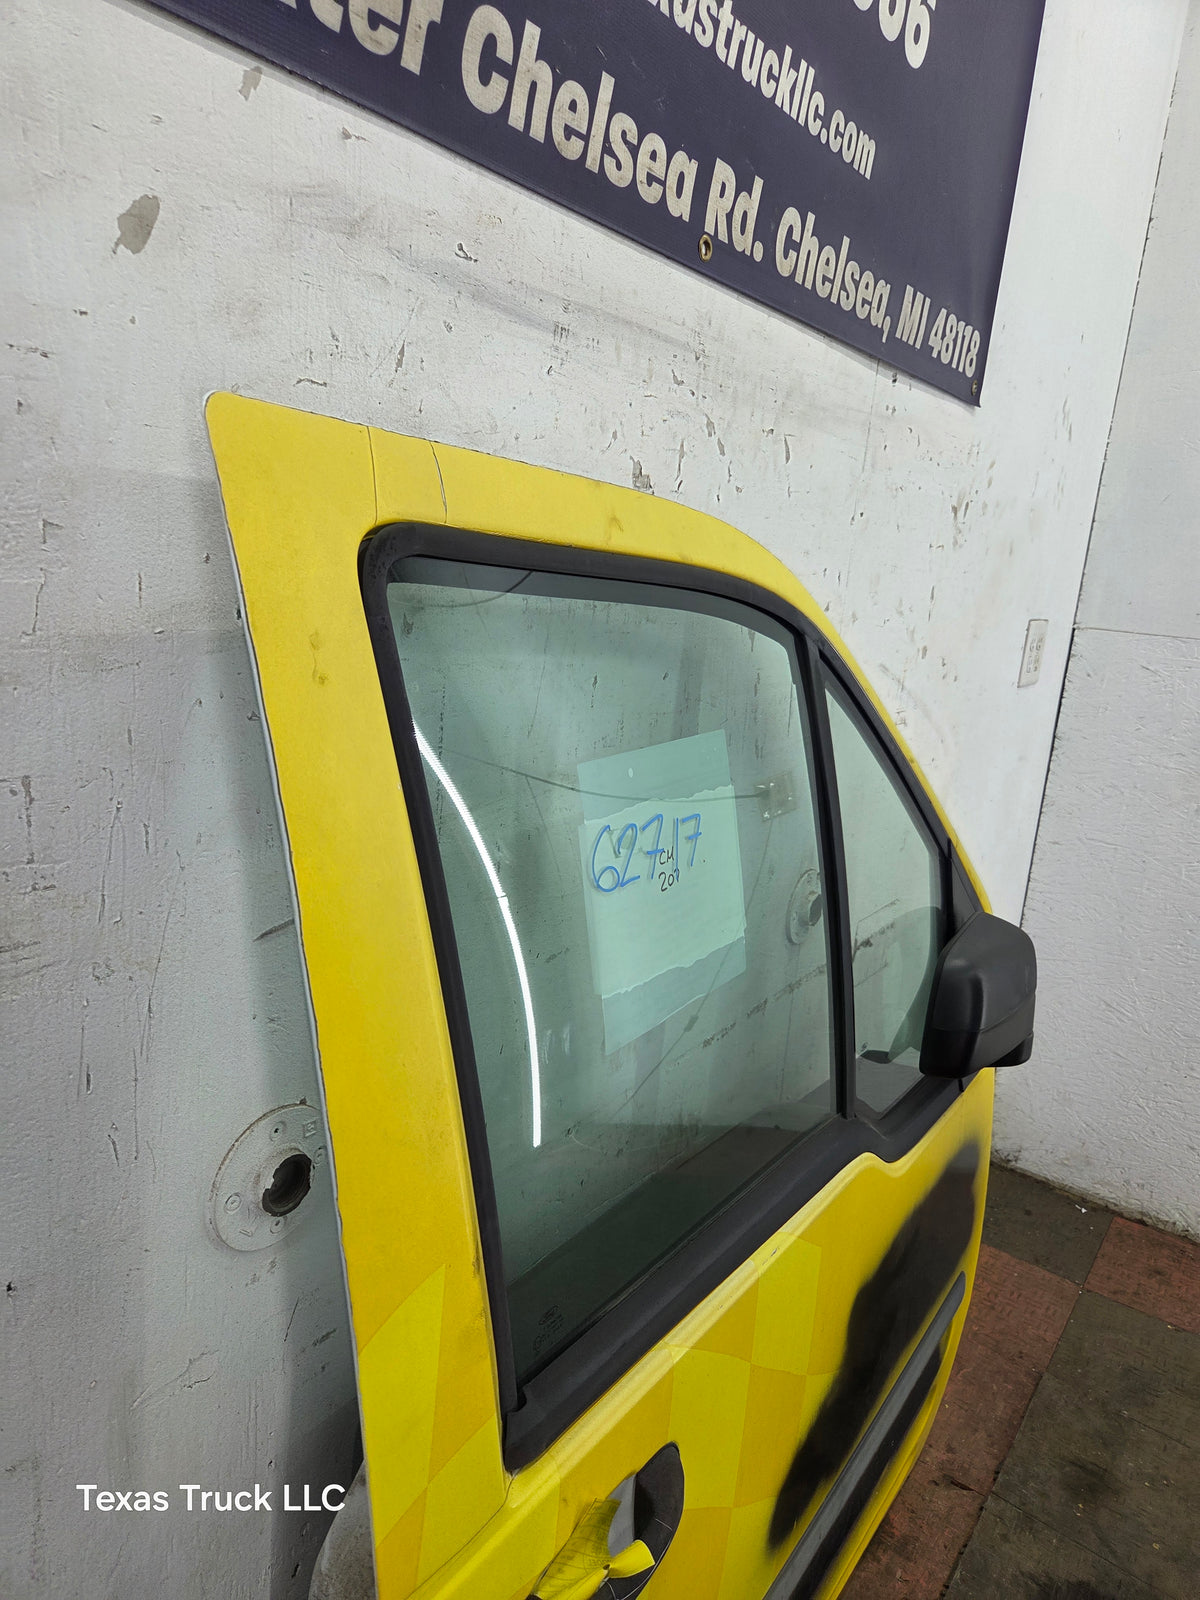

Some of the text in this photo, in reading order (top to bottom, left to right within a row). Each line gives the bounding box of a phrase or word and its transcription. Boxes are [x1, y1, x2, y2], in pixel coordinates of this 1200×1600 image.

[461, 5, 698, 222] Chelsea
[704, 157, 764, 262] Rd.
[775, 206, 891, 343] Chelsea,
[895, 284, 931, 349] MI
[928, 308, 981, 378] 48118
